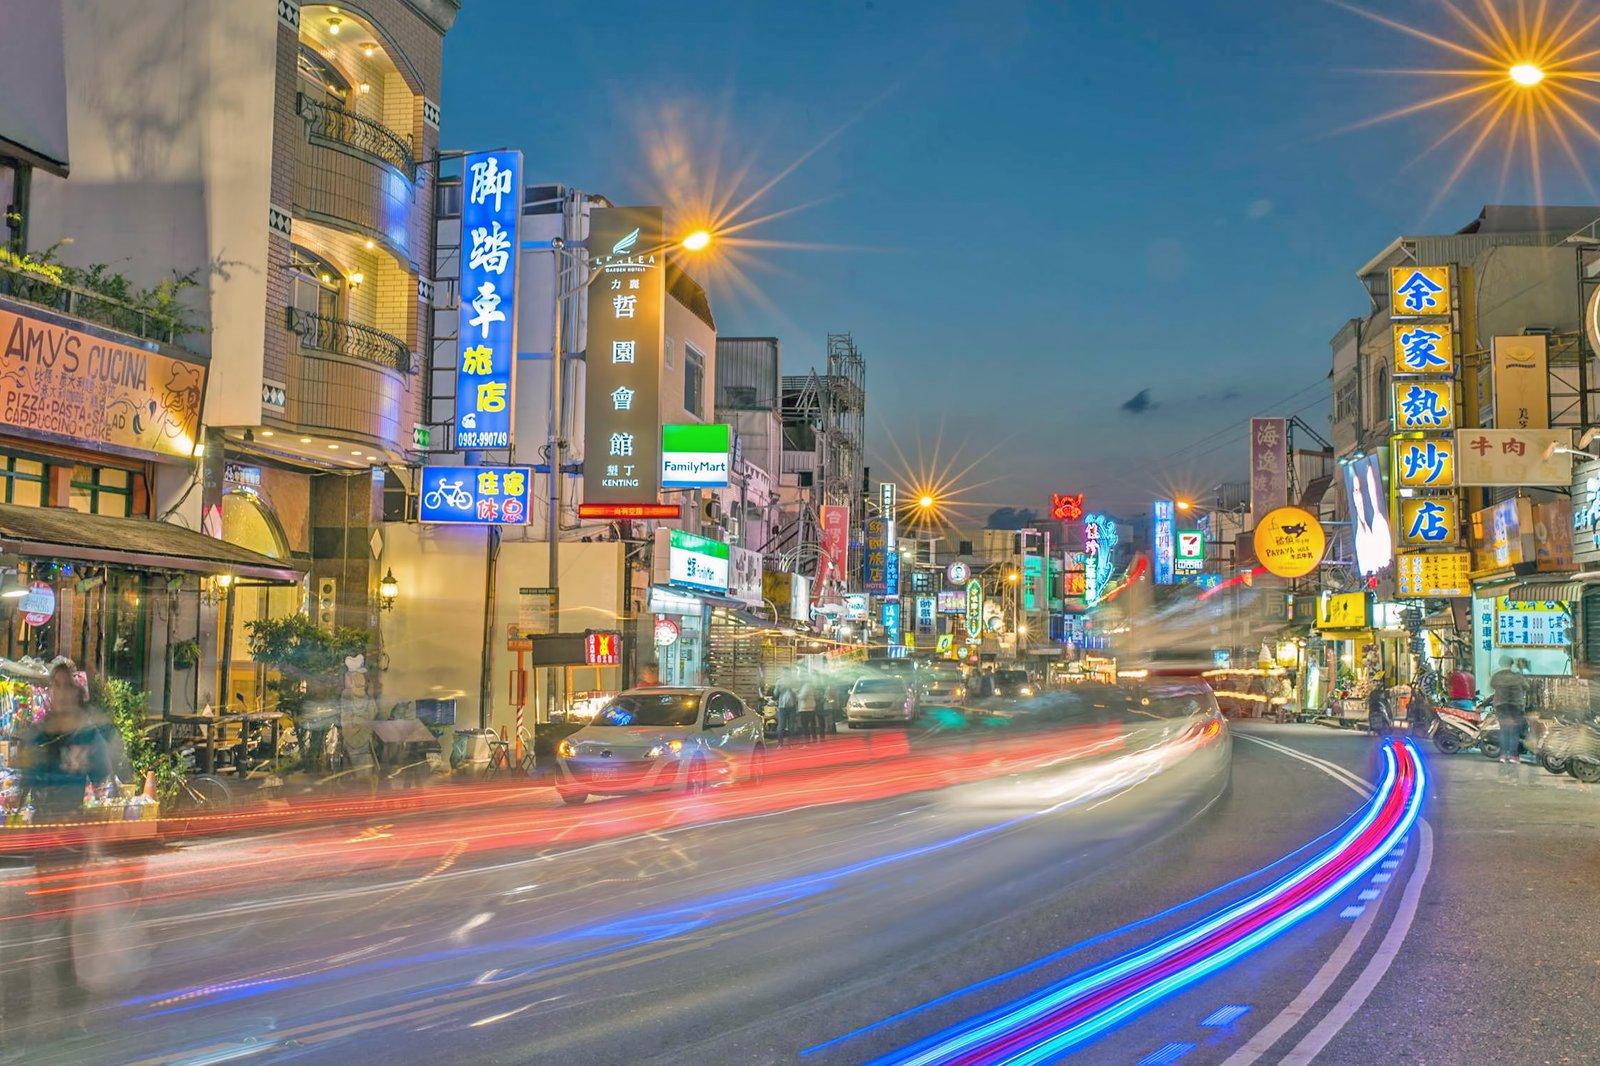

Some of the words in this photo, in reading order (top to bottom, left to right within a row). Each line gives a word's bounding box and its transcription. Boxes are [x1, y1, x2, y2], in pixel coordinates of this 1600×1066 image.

[88, 345, 147, 391] CUCINA
[609, 294, 638, 457] 哲園會館
[7, 391, 45, 411] PIZZA
[52, 400, 86, 420] PASTA
[93, 410, 125, 429] SALAD
[1397, 271, 1447, 543] 余家熱炒店
[5, 407, 76, 434] CAPPUCCINO
[85, 423, 112, 441] CAKE
[458, 432, 507, 447] 0982-990749
[1470, 436, 1526, 457] 牛肉
[606, 464, 635, 477] 墾丁
[664, 461, 726, 473] FamilyMart
[477, 471, 525, 496] 住宿
[602, 479, 639, 487] KENTING
[477, 497, 523, 522] 休息
[1482, 613, 1492, 651] 停車場
